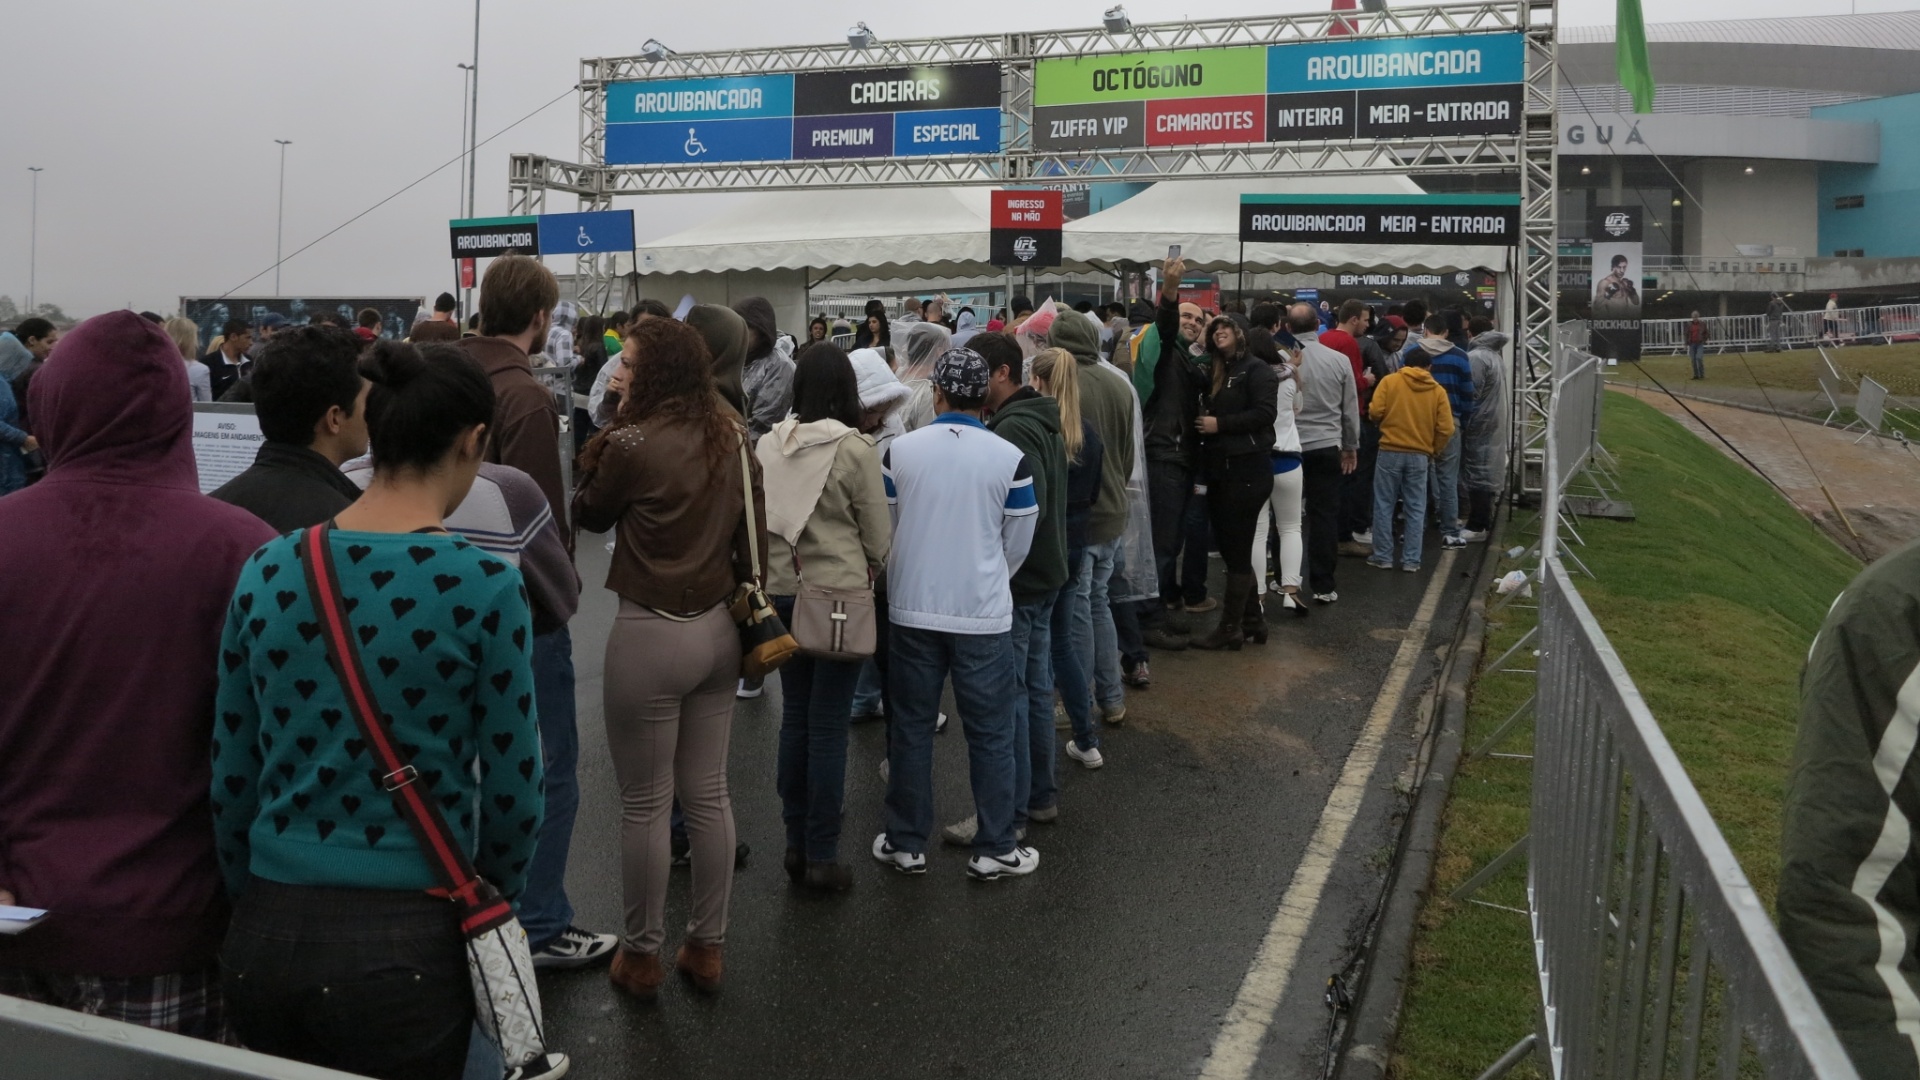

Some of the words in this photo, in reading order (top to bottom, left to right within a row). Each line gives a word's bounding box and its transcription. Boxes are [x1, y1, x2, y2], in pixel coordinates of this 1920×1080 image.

[1307, 49, 1482, 81] ARQUIBANCADA
[1092, 60, 1204, 92] OCTÓGONO
[635, 87, 762, 113] ARQUIBANCADA
[850, 78, 940, 105] CADEIRAS
[1050, 119, 1098, 140] ZUFFA
[1102, 116, 1129, 137] VIP
[1156, 110, 1254, 133] CAMAROTES
[1278, 106, 1344, 129] INTEIRA
[812, 127, 874, 148] PREMIUM
[913, 122, 981, 144] ESPECIAL
[1007, 199, 1045, 209] INGRESSO
[1011, 212, 1022, 222] NA
[1023, 210, 1041, 222] MÃO
[1252, 214, 1366, 233] ARQUIBANCADA
[1380, 215, 1417, 233] MEIA
[1431, 216, 1506, 234] ENTRADA
[1605, 215, 1631, 224] UFC
[457, 232, 532, 250] ARQUIBANCADA
[1014, 239, 1037, 249] UFC
[192, 431, 220, 440] MAGENS
[231, 434, 265, 442] ANDAMENT
[217, 422, 237, 431] AVISO:
